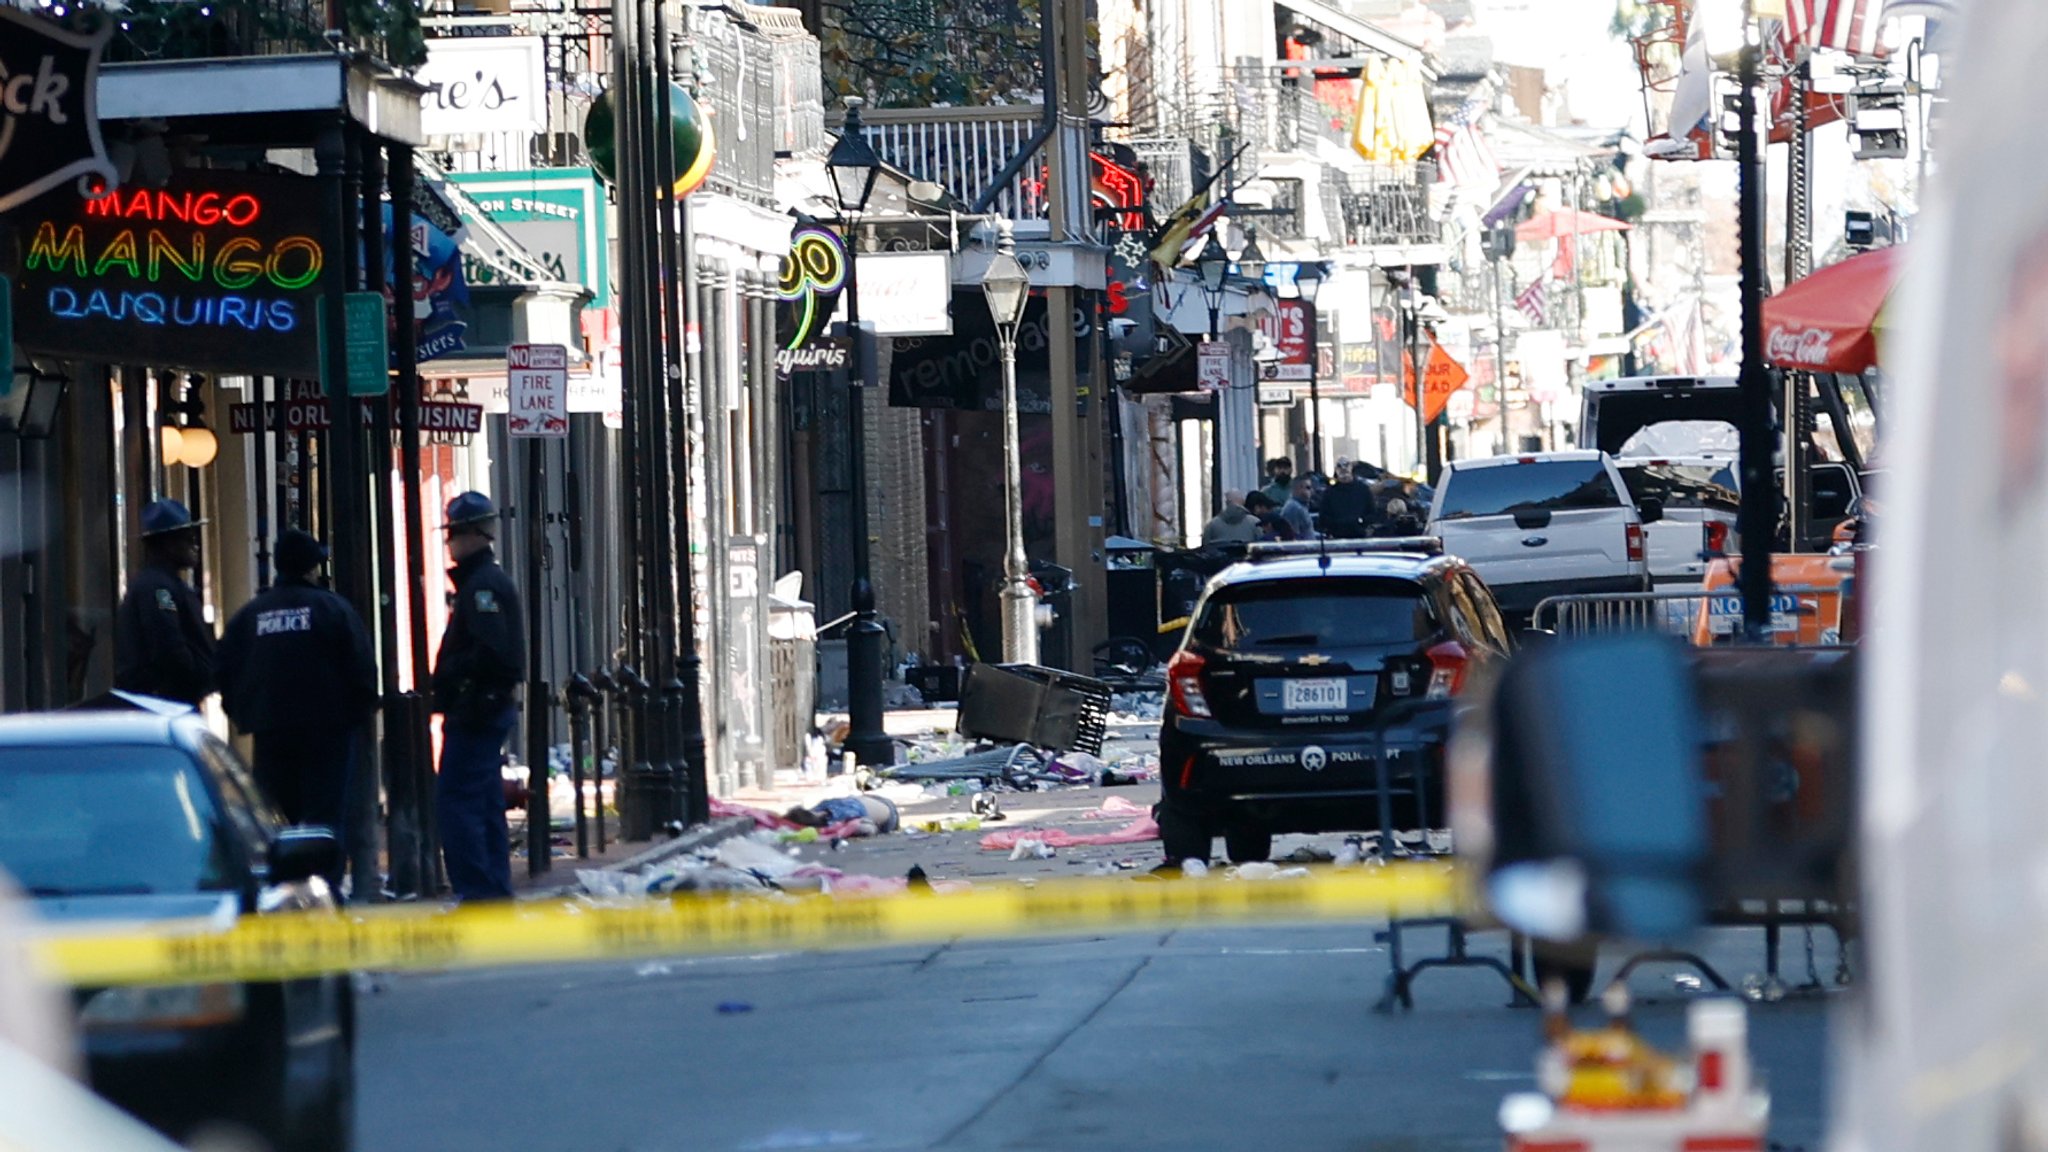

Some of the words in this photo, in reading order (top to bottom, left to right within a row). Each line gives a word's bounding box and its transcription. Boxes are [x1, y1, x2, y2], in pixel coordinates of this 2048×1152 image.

[2, 54, 68, 124] ck
[86, 184, 260, 226] MANGO
[511, 198, 578, 220] STREET
[27, 220, 323, 289] MANGO
[49, 287, 297, 332] DAIQUIRIS
[419, 331, 456, 361] sters
[510, 348, 529, 367] NO
[777, 342, 847, 374] quiris
[522, 375, 553, 390] FIRE
[520, 396, 555, 410] LANE
[257, 614, 311, 636] POLICE
[1295, 686, 1343, 703] 286101
[1219, 755, 1244, 767] NEW
[1245, 753, 1296, 767] ORLEANS
